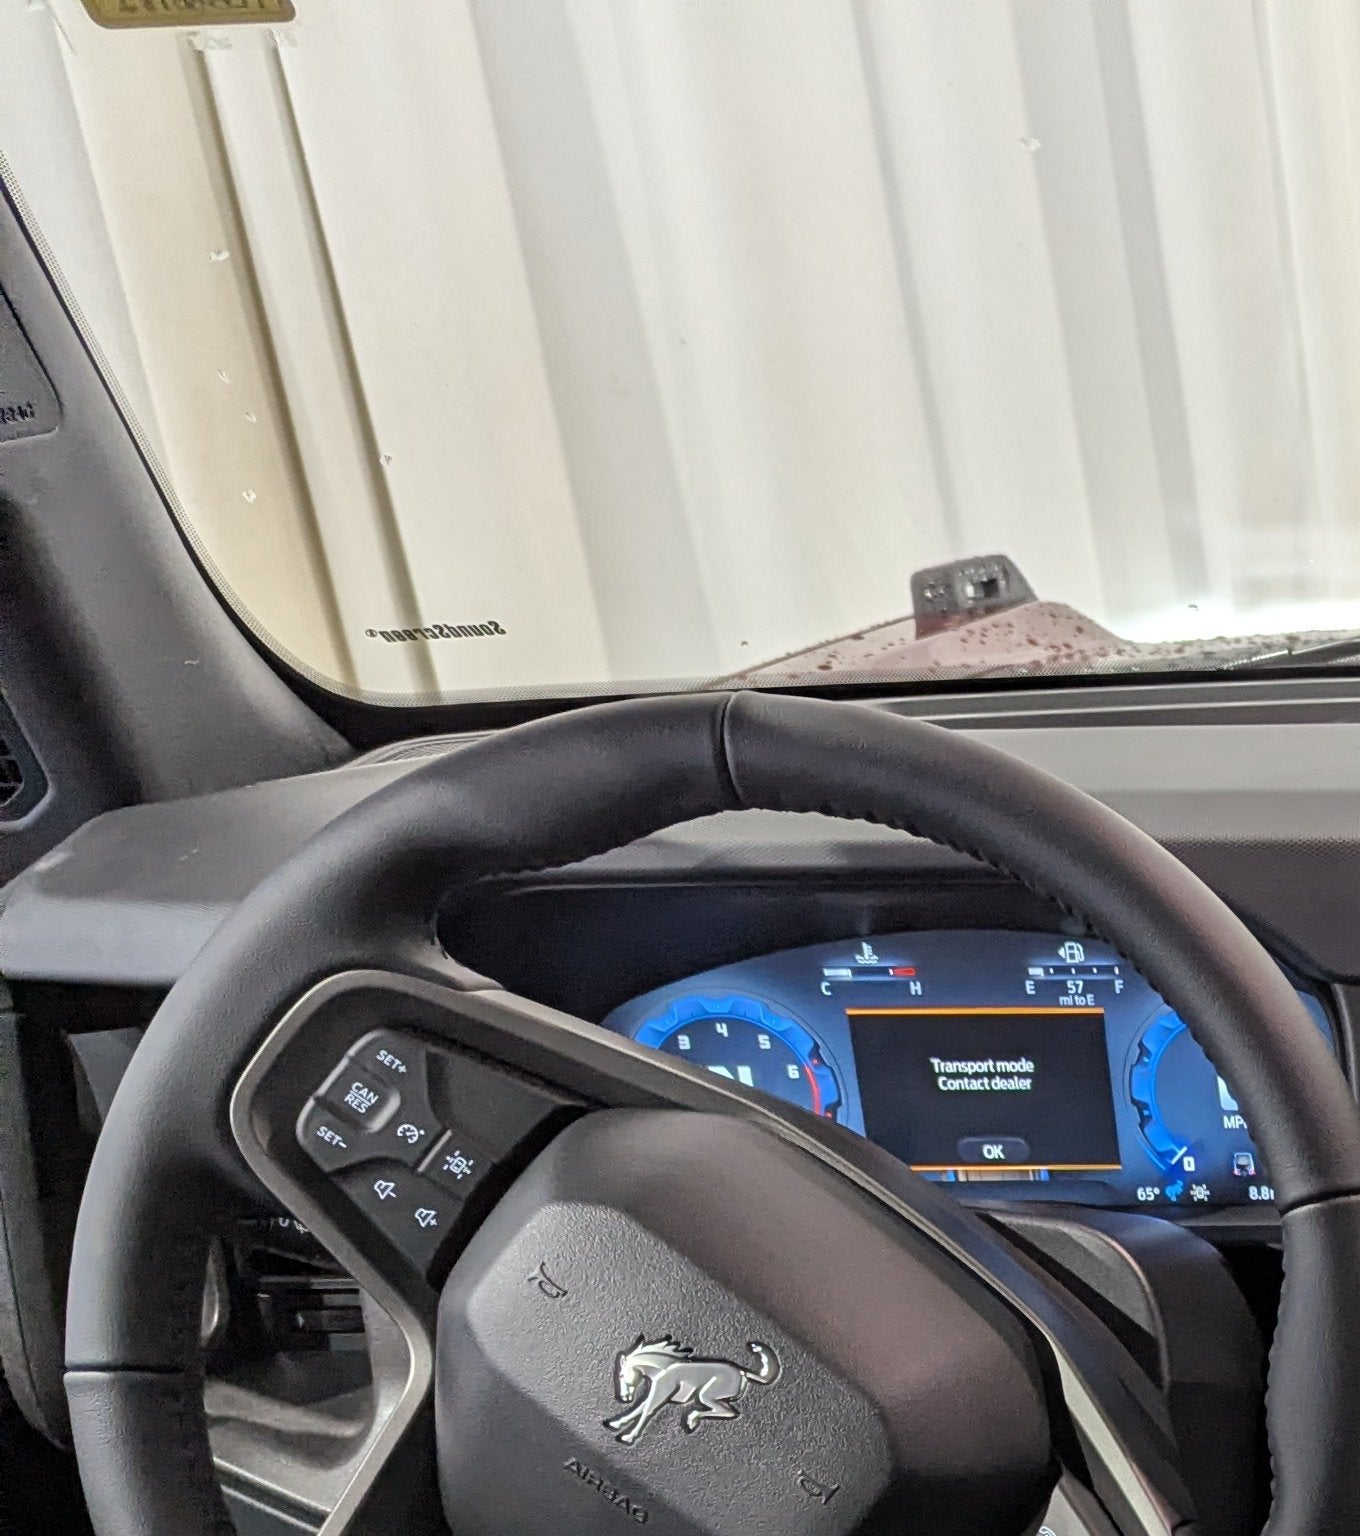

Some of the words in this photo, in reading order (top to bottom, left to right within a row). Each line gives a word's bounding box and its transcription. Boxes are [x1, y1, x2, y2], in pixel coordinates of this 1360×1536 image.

[821, 981, 832, 996] C
[909, 981, 923, 996] H
[1025, 980, 1036, 995] E
[1066, 980, 1084, 994] 57
[1114, 980, 1124, 994] F
[1075, 994, 1086, 1006] to
[715, 1023, 729, 1038] 4
[677, 1035, 691, 1050] 3
[757, 1035, 771, 1049] 5
[375, 1049, 408, 1074] SET+
[929, 1057, 995, 1075] Transport
[996, 1058, 1035, 1072] mode
[786, 1064, 800, 1079] 6
[937, 1076, 990, 1091] Contact
[992, 1076, 1033, 1090] dealer
[350, 1081, 380, 1105] CAN
[343, 1093, 370, 1115] RES
[1223, 1115, 1248, 1129] MP
[982, 1144, 1006, 1160] OK
